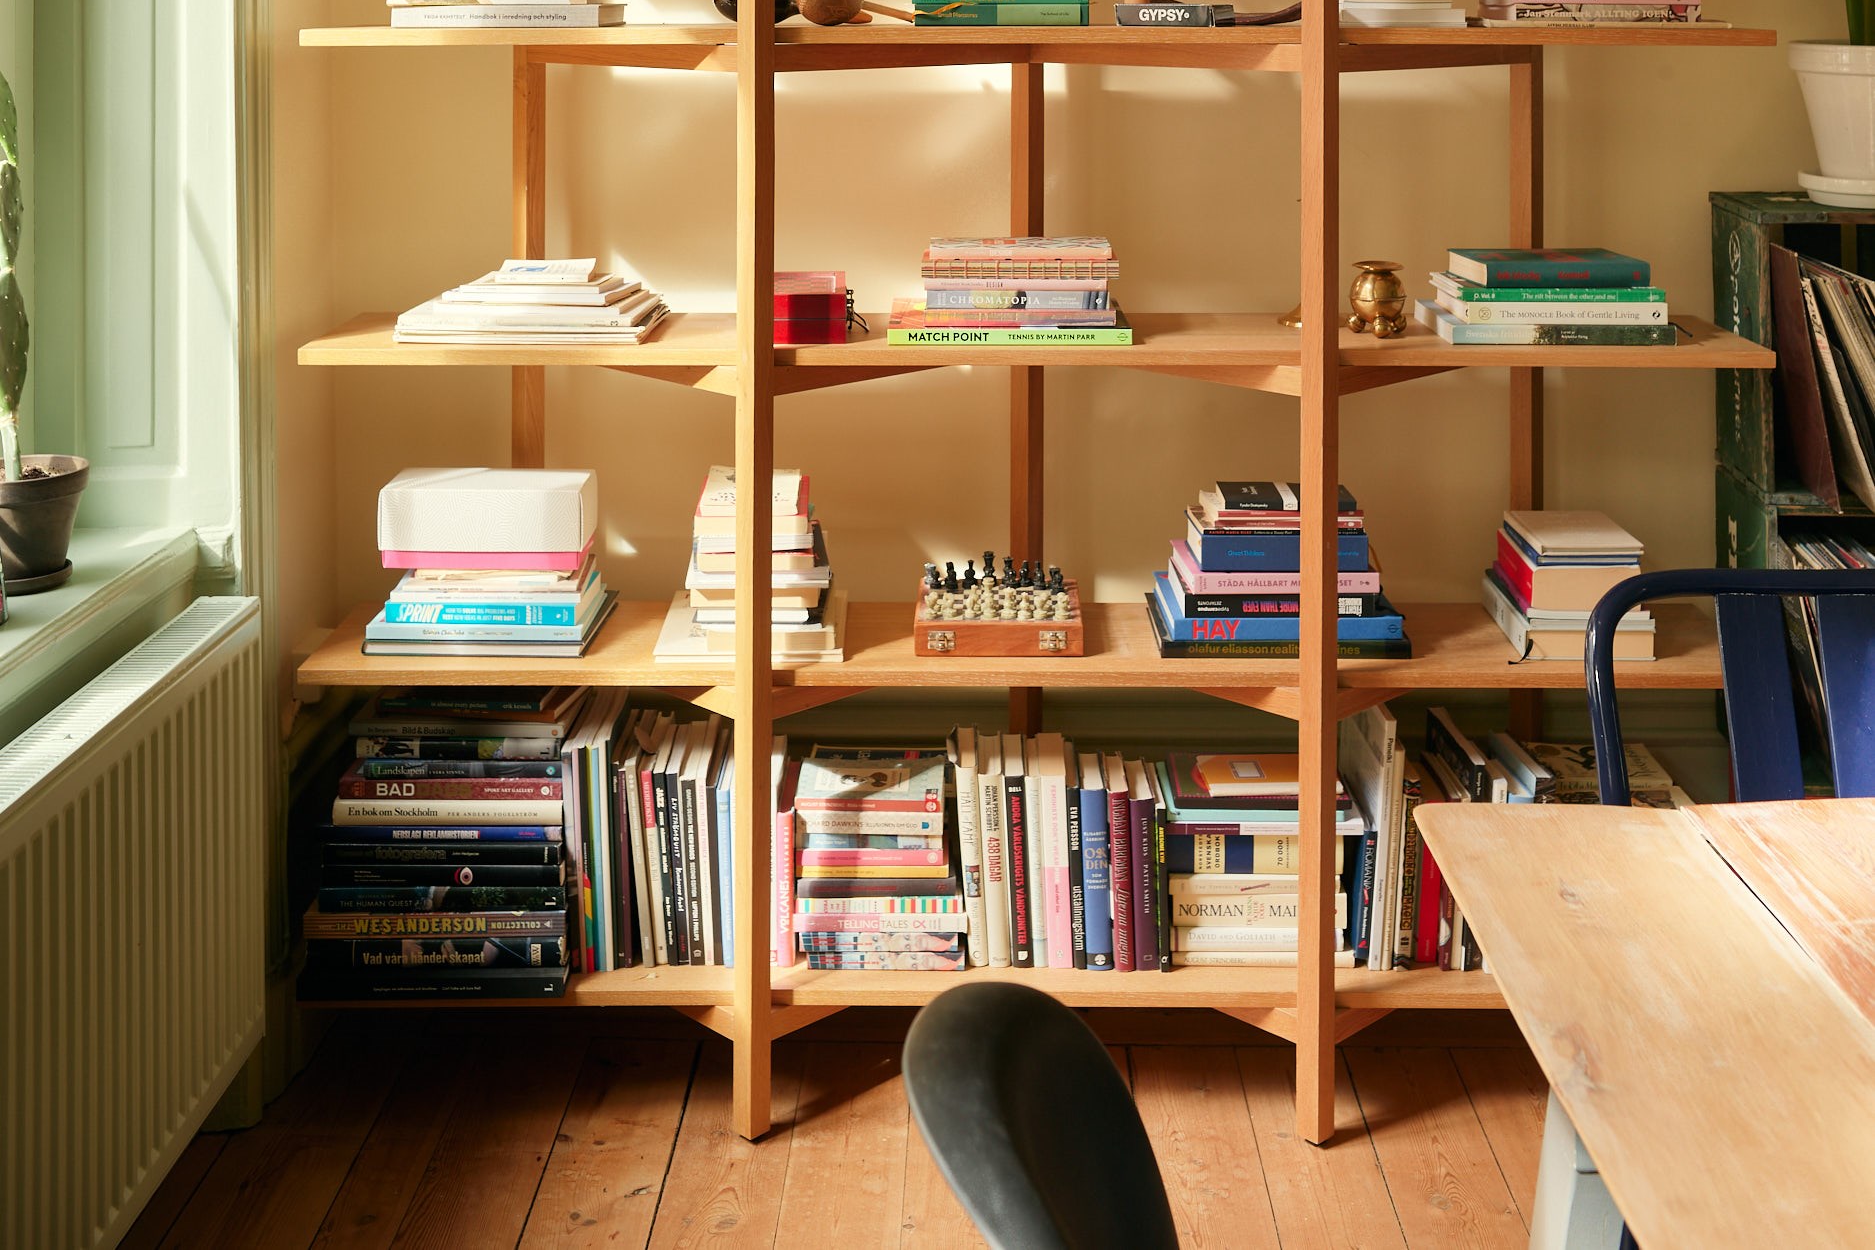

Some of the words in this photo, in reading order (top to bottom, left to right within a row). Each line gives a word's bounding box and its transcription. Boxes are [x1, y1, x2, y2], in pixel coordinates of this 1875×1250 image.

[470, 14, 498, 22] Handbok
[502, 14, 532, 22] inredning
[533, 14, 545, 22] och
[546, 14, 566, 22] styling
[1139, 9, 1185, 22] GYPSY
[1595, 10, 1640, 18] ALLTING
[950, 296, 1041, 305] CHROMATOPIA
[1500, 310, 1514, 318] The
[1556, 310, 1574, 318] Book
[1575, 310, 1586, 318] of
[1587, 310, 1612, 319] Gentle
[1614, 310, 1640, 320] Living
[908, 333, 950, 342] MATCH
[954, 333, 990, 342] POINT
[1218, 579, 1244, 587] STÄDA
[1247, 579, 1288, 587] HÅLLBART
[396, 604, 444, 622] SPRINT
[1243, 601, 1260, 613] EVER
[1260, 601, 1279, 613] THAN
[1192, 620, 1240, 639] HAY
[1188, 644, 1221, 654] olafur
[1222, 644, 1270, 654] eliasson
[1270, 644, 1300, 654] realit
[1337, 645, 1360, 654] ines
[402, 726, 416, 736] Bild
[424, 726, 456, 736] Budskap
[1386, 738, 1394, 764] Panelki
[376, 766, 425, 776] Landskapen
[376, 783, 415, 796] BAD
[656, 788, 664, 808] JAZZ
[348, 807, 360, 818] En
[362, 807, 378, 818] bok
[378, 807, 393, 818] om
[394, 807, 438, 818] Stockholm
[1011, 796, 1021, 824] ANDRA
[1070, 806, 1078, 818] EVA
[1112, 799, 1126, 836] INGMAR
[672, 812, 680, 858] STRÖMQUIST
[1071, 820, 1080, 850] PERSSON
[987, 837, 1000, 854] 438
[1012, 826, 1024, 887] VÄRLDSKRIGETS
[1114, 837, 1129, 882] BERGMAN
[1277, 858, 1284, 866] 70
[988, 855, 1001, 882] DAGAR
[1086, 860, 1108, 870] DEN
[1364, 848, 1376, 890] ROMANIA
[353, 900, 386, 908] HUMAN
[388, 900, 413, 908] QUEST
[1178, 904, 1244, 917] NORMAN
[1015, 888, 1027, 945] VÄNDPUNKTER
[1401, 896, 1412, 930] MAGIC
[353, 918, 392, 934] WES
[396, 918, 487, 934] ANDERSON
[838, 920, 878, 928] TELLING
[882, 920, 908, 928] TALES
[1189, 932, 1216, 940] DAVID
[1236, 932, 1276, 940] GOLIATH
[1118, 928, 1129, 965] magica
[362, 952, 383, 966] Vad
[410, 952, 446, 966] händer
[449, 952, 486, 966] skapat
